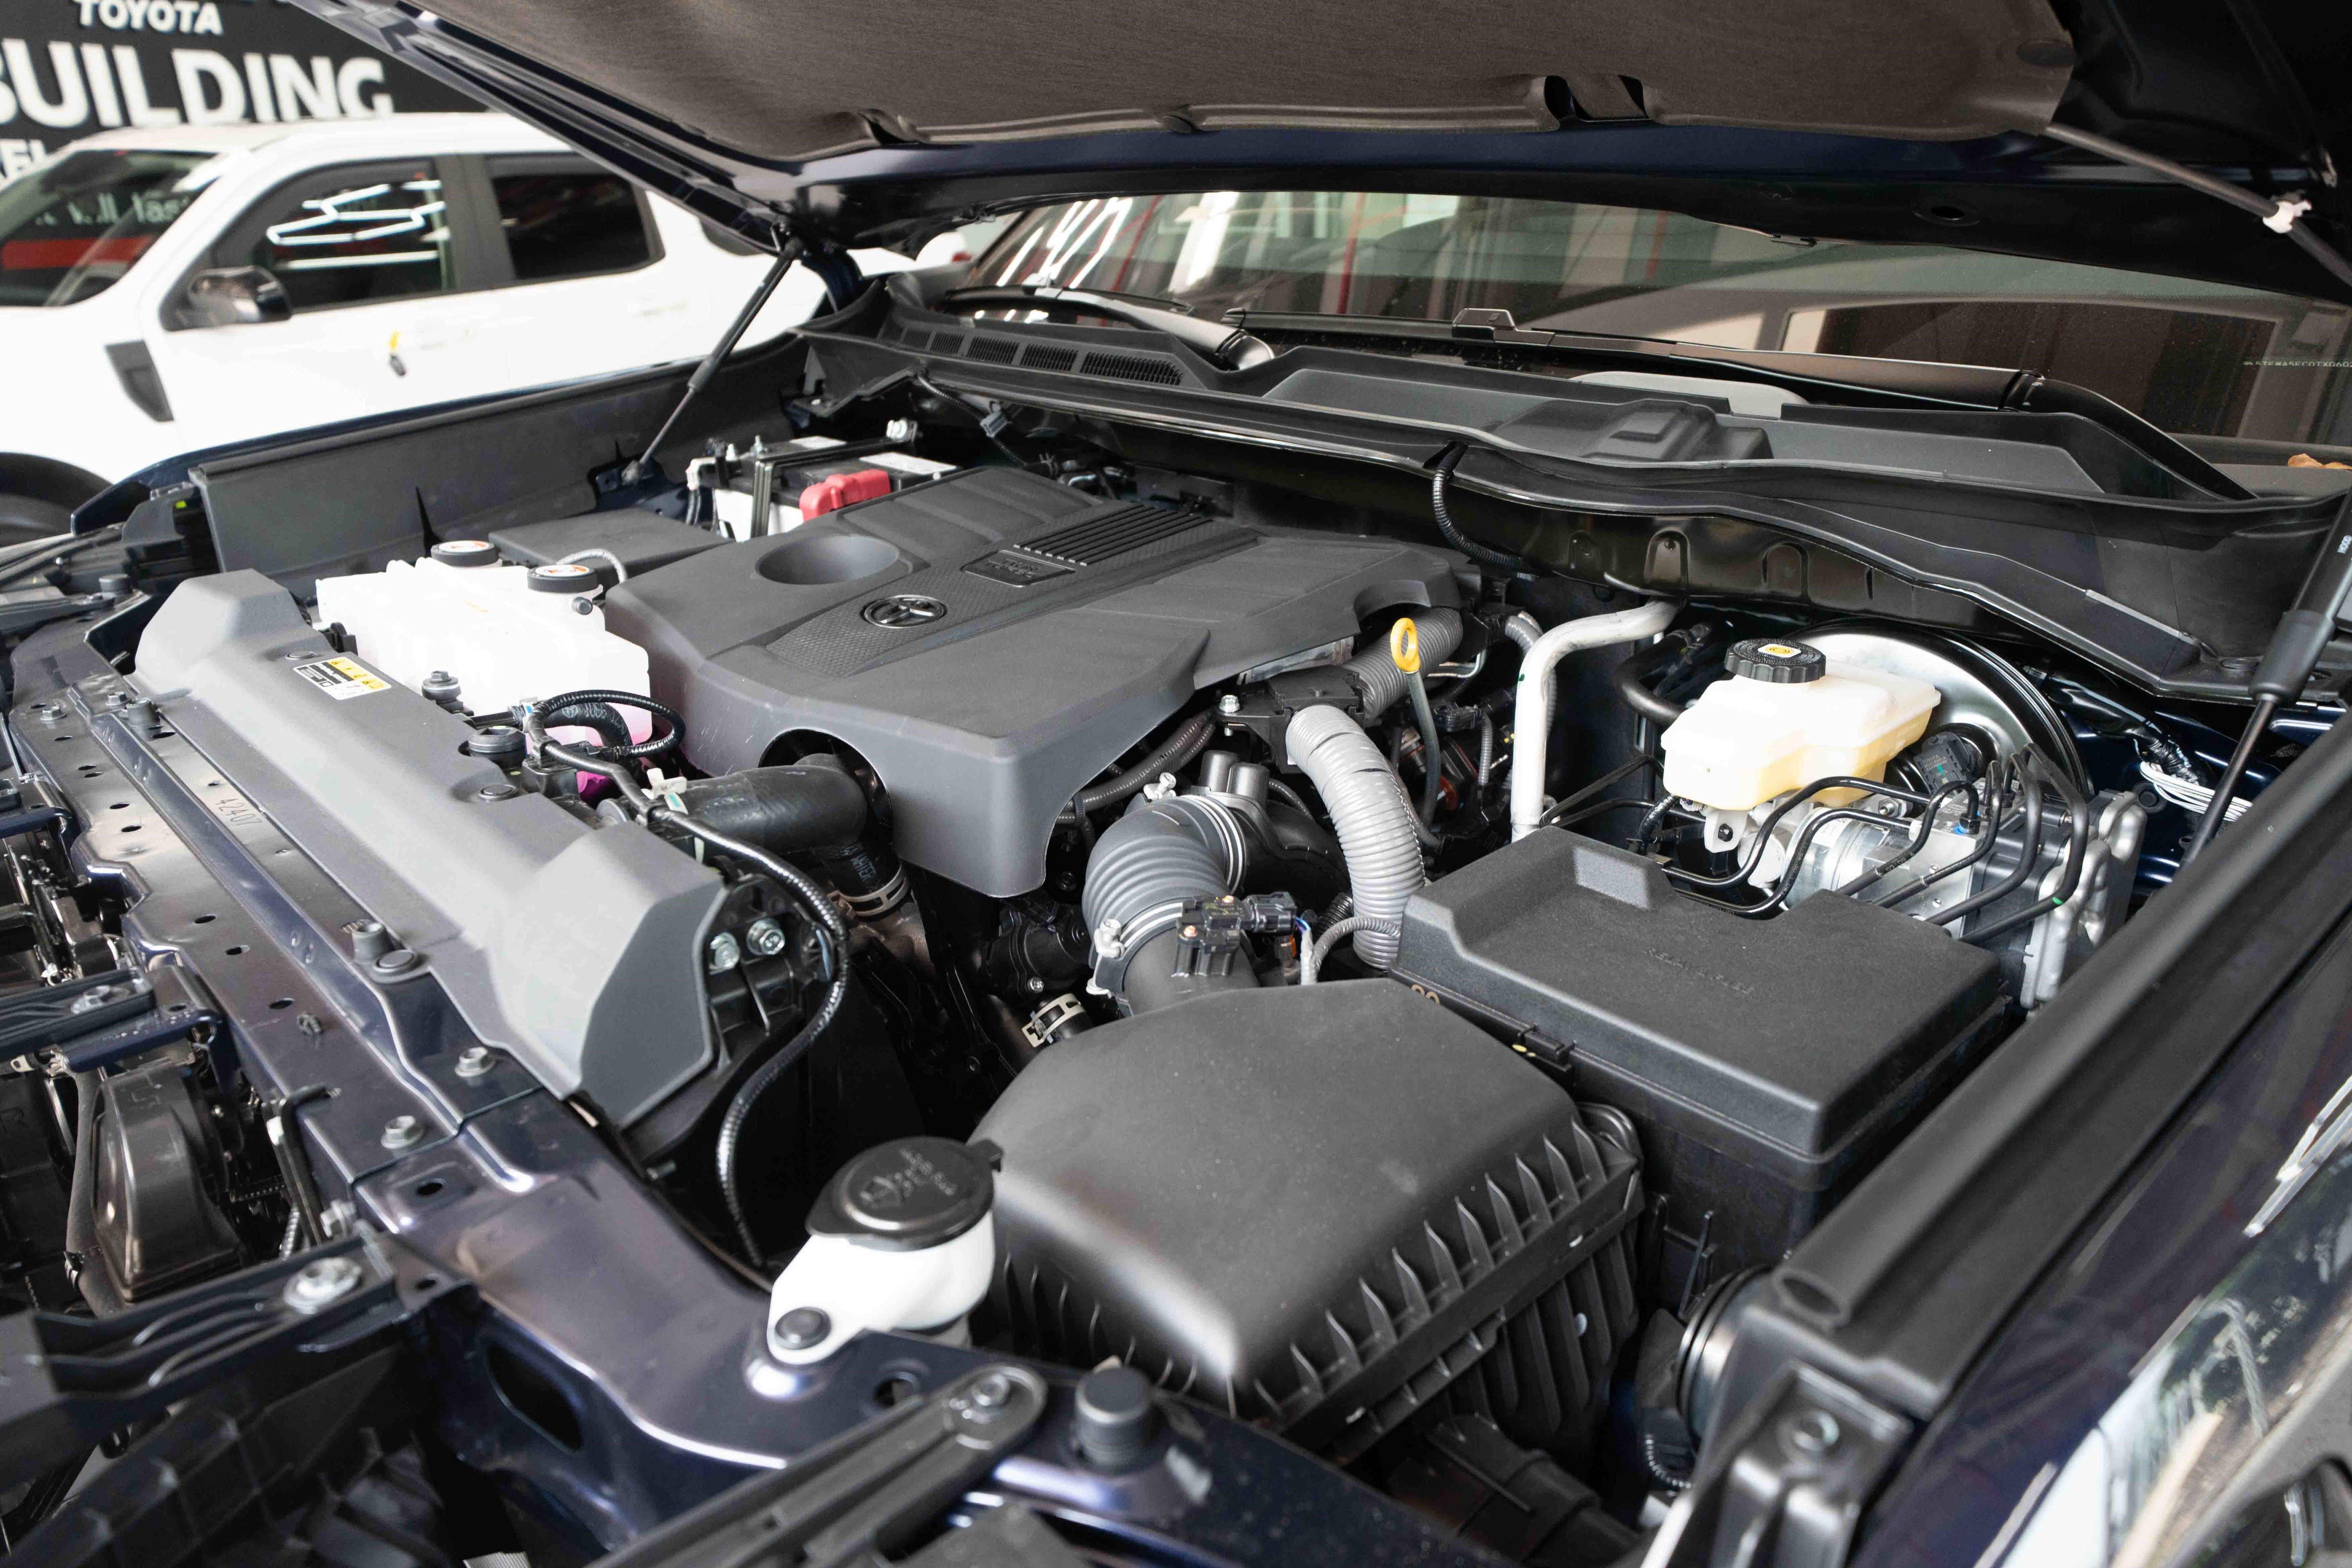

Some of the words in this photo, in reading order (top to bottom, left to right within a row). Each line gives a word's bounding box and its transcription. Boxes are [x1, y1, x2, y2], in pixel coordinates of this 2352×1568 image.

[74, 0, 224, 36] TOYOTA
[0, 38, 394, 128] UILDING
[215, 798, 263, 826] 42407
